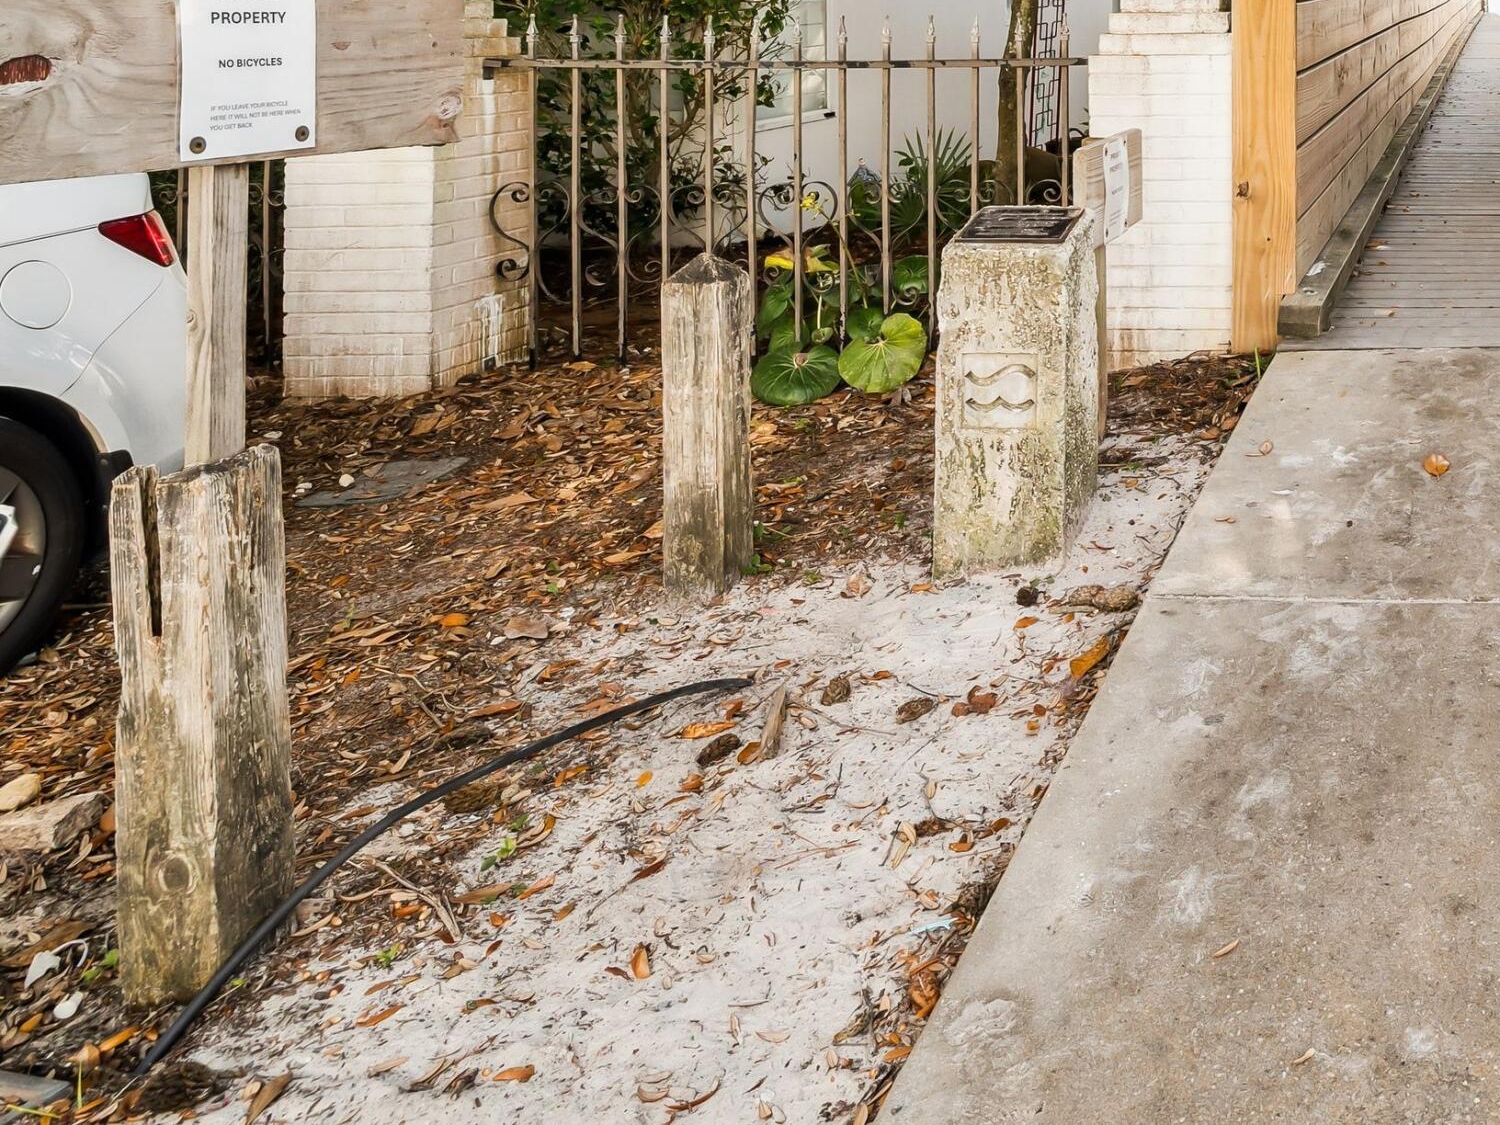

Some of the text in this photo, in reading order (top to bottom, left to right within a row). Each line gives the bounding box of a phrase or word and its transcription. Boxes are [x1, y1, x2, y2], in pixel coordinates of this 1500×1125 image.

[211, 12, 286, 24] PROPERTY
[219, 58, 282, 68] NO BICYCLES
